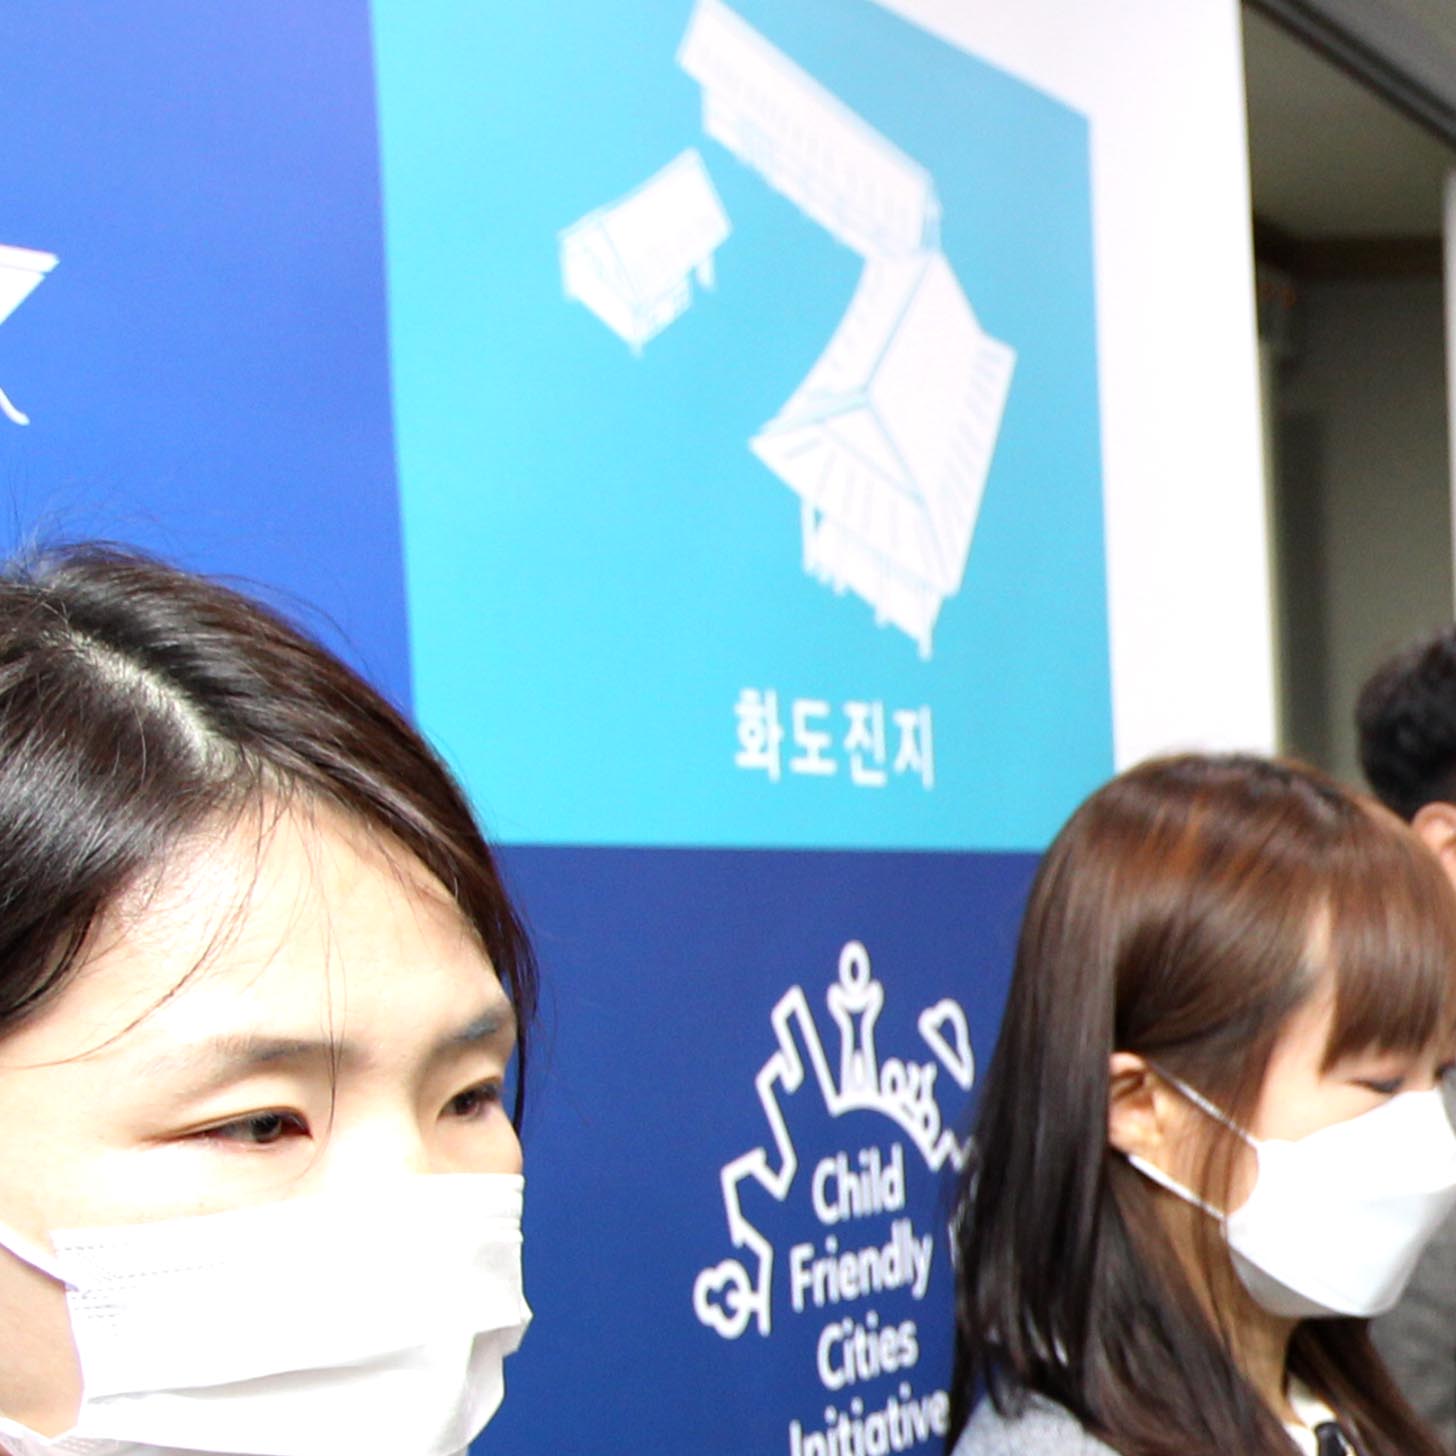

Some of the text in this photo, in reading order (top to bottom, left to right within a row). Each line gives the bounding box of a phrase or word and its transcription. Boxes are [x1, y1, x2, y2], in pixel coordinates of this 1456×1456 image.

[734, 687, 935, 791] 화도진지
[812, 1142, 905, 1225] Child
[790, 1218, 934, 1312] Friendly
[817, 1310, 920, 1391] Cities
